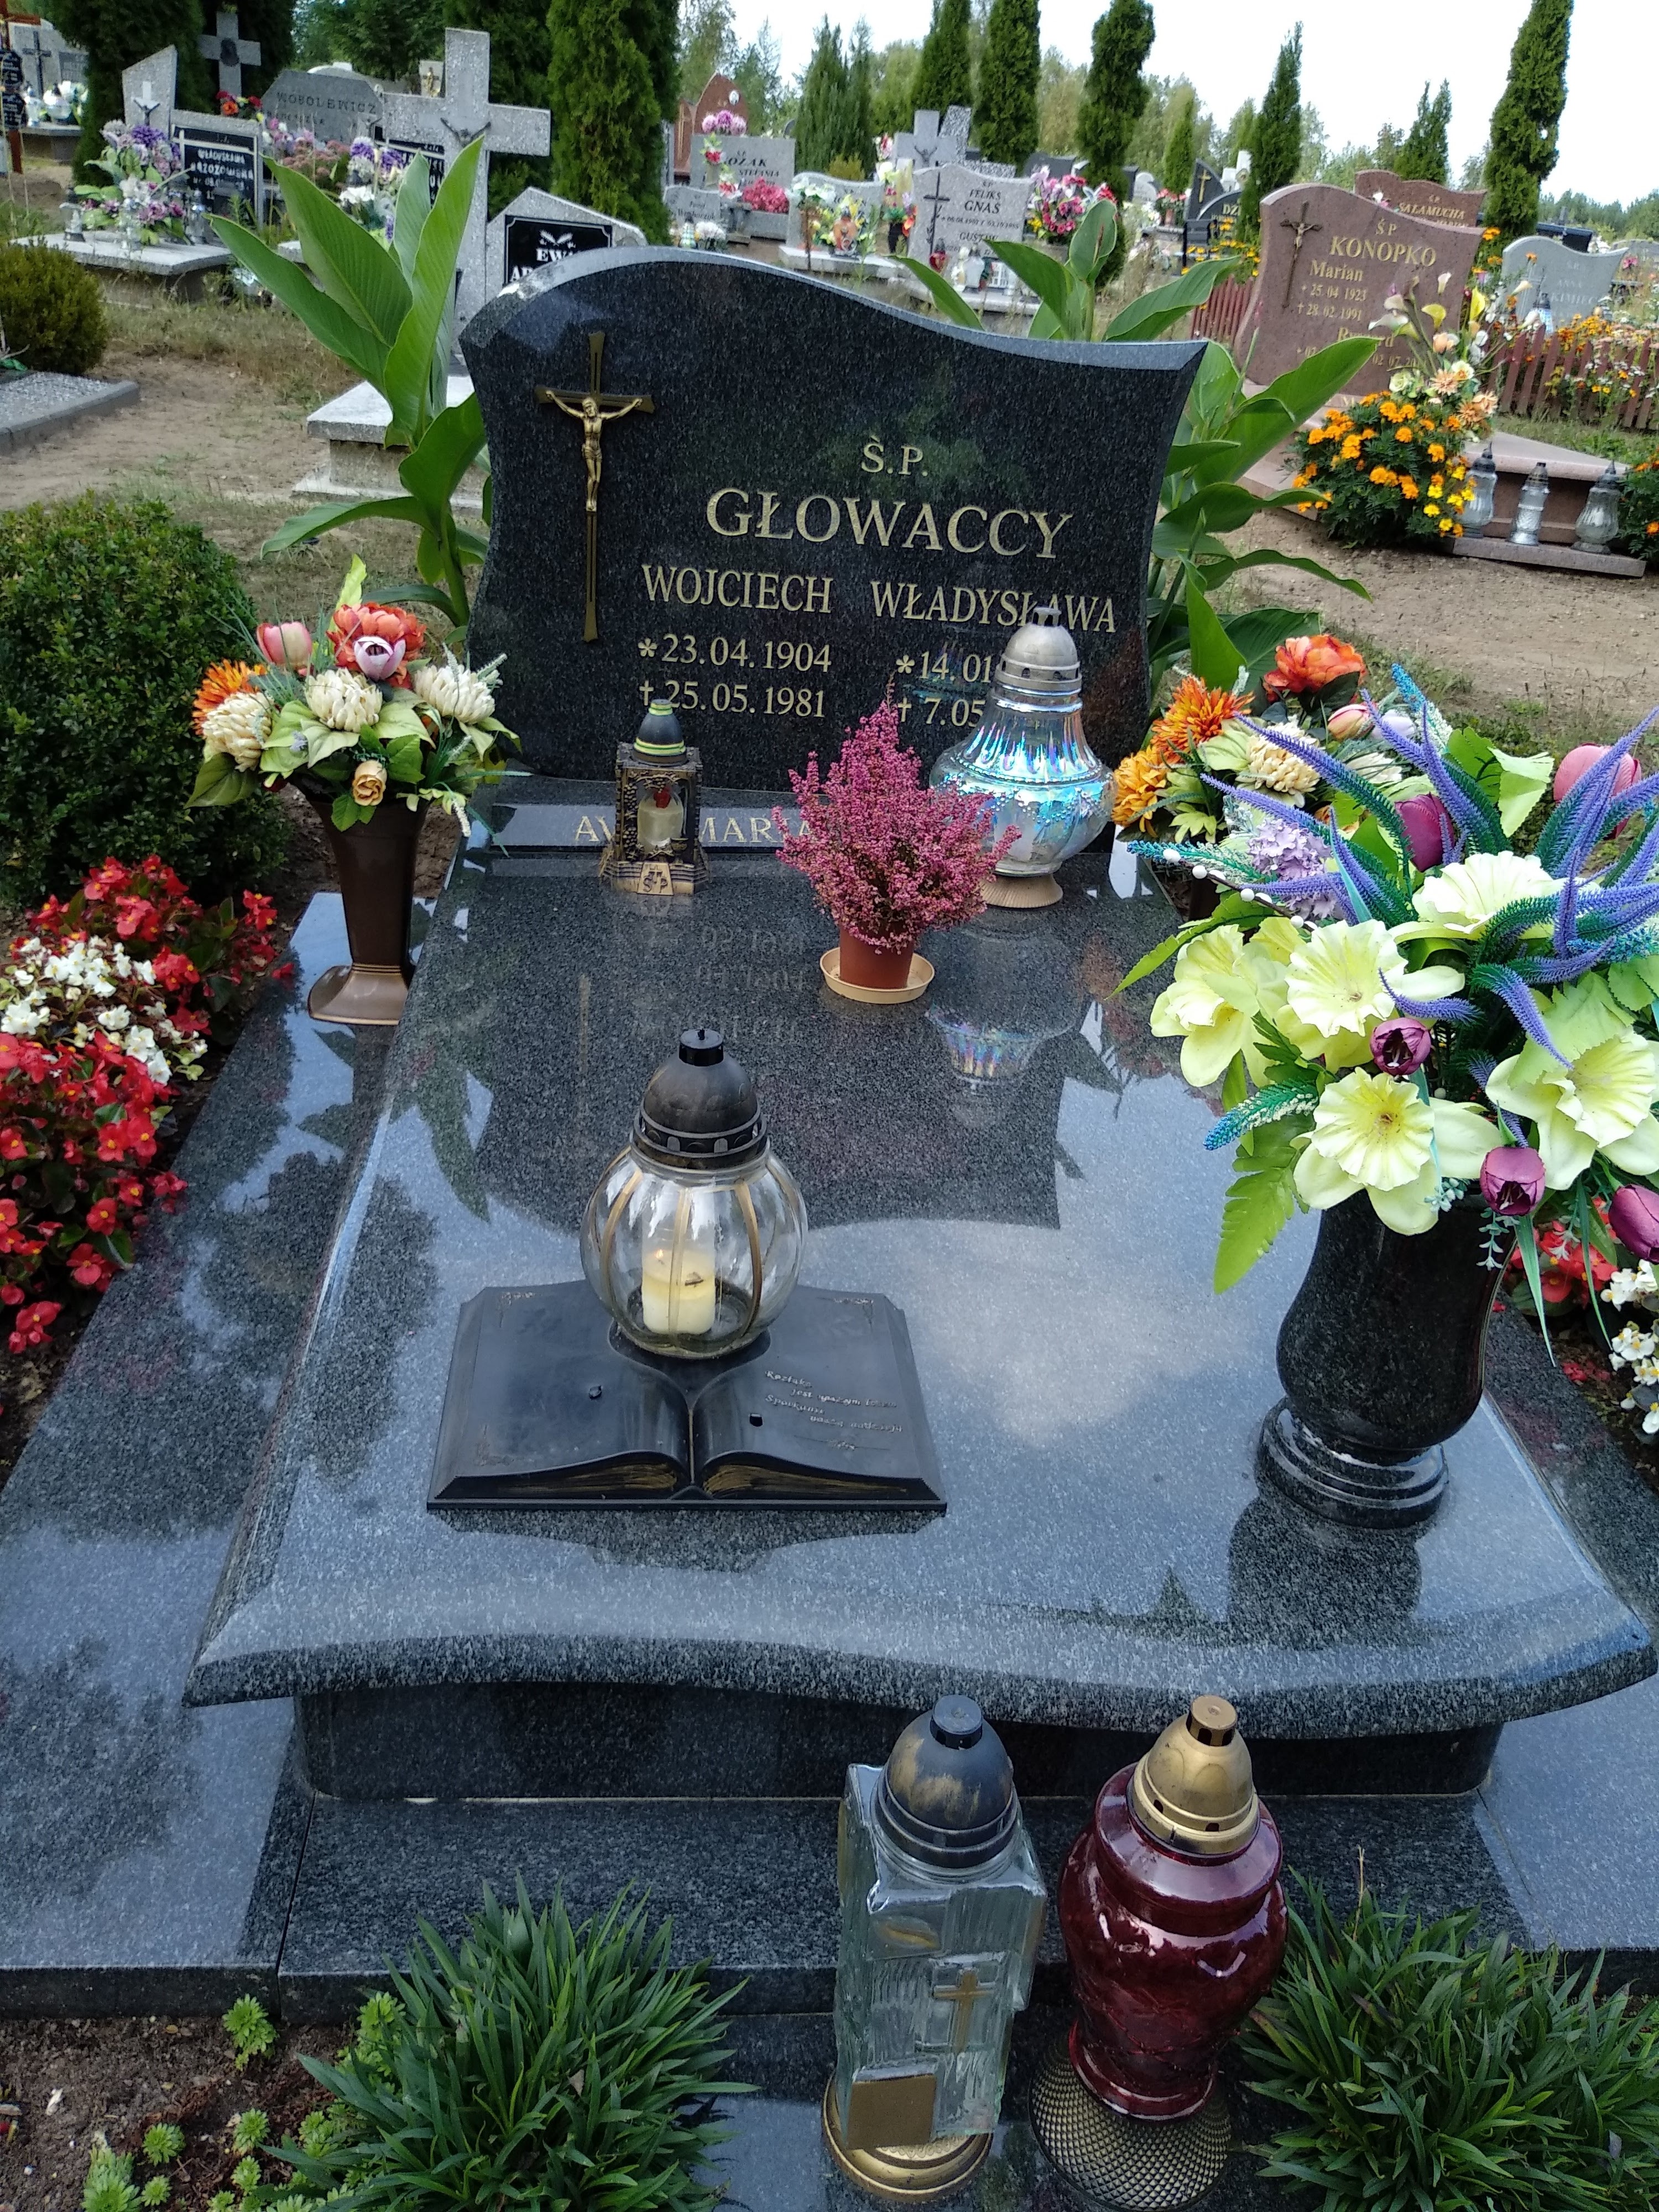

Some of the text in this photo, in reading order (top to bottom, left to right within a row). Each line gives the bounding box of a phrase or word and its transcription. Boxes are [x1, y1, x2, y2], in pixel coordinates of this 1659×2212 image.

[1329, 236, 1437, 267] KONOPKO
[1309, 259, 1364, 281] Marian
[706, 487, 1073, 559] GŁOWACCY
[641, 564, 834, 613] WOJCIECH
[575, 815, 616, 842] AV
